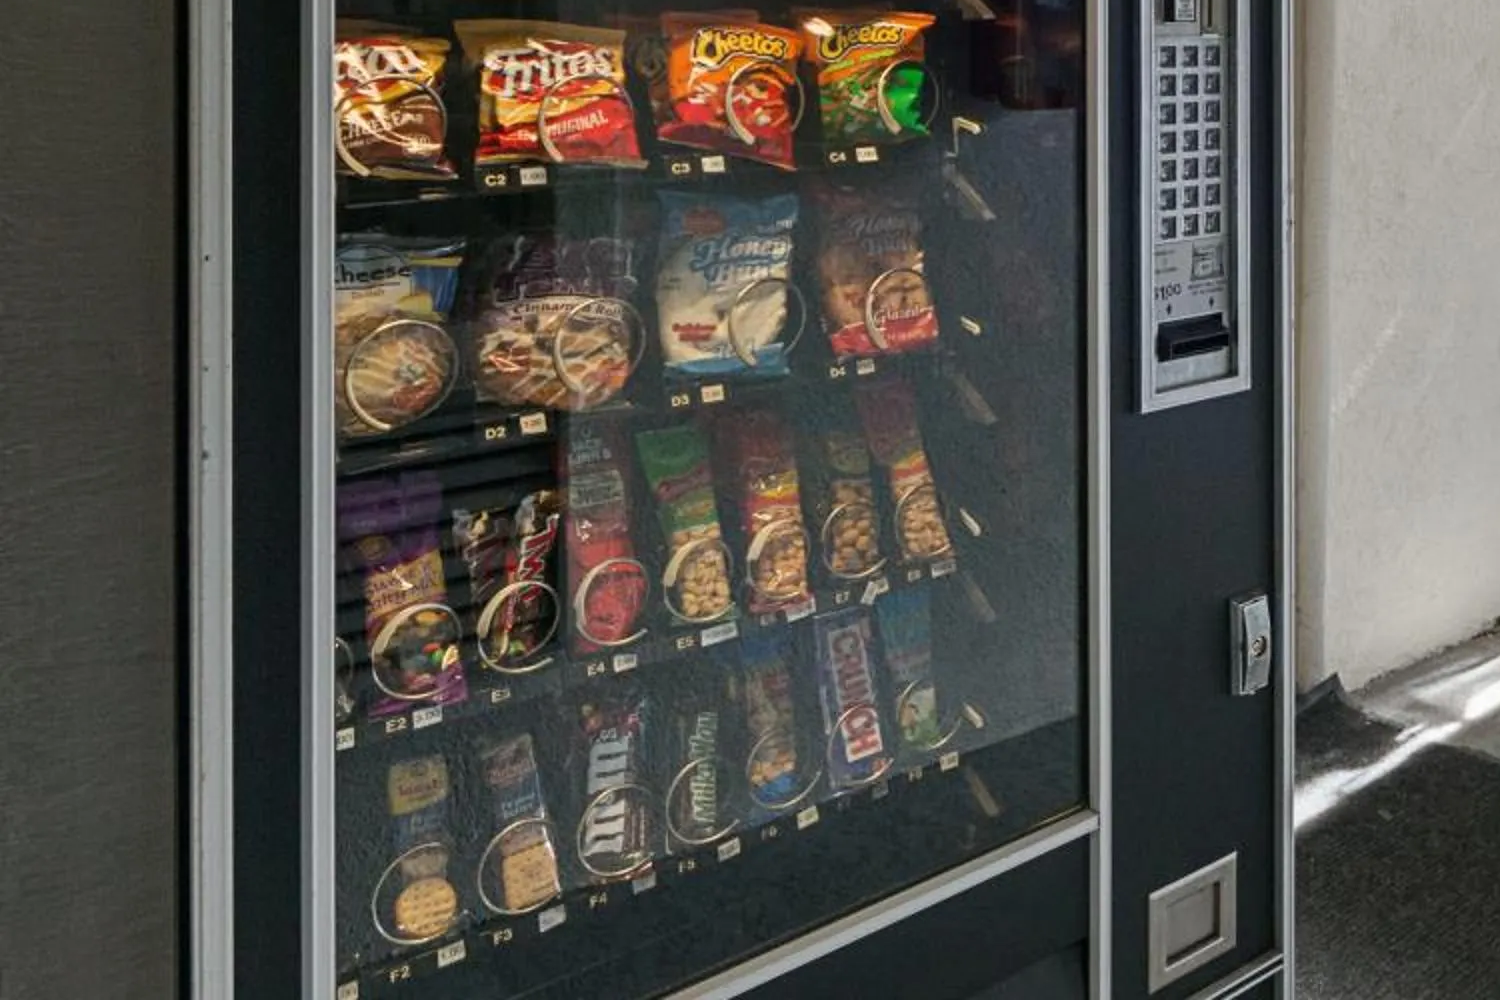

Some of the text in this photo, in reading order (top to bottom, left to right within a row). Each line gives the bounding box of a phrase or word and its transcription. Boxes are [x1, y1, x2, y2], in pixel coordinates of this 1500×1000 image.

[695, 29, 788, 61] Cheetos
[821, 24, 902, 60] Cheetos
[483, 45, 614, 98] Fritos
[484, 173, 507, 187] C2
[485, 426, 507, 440] D2
